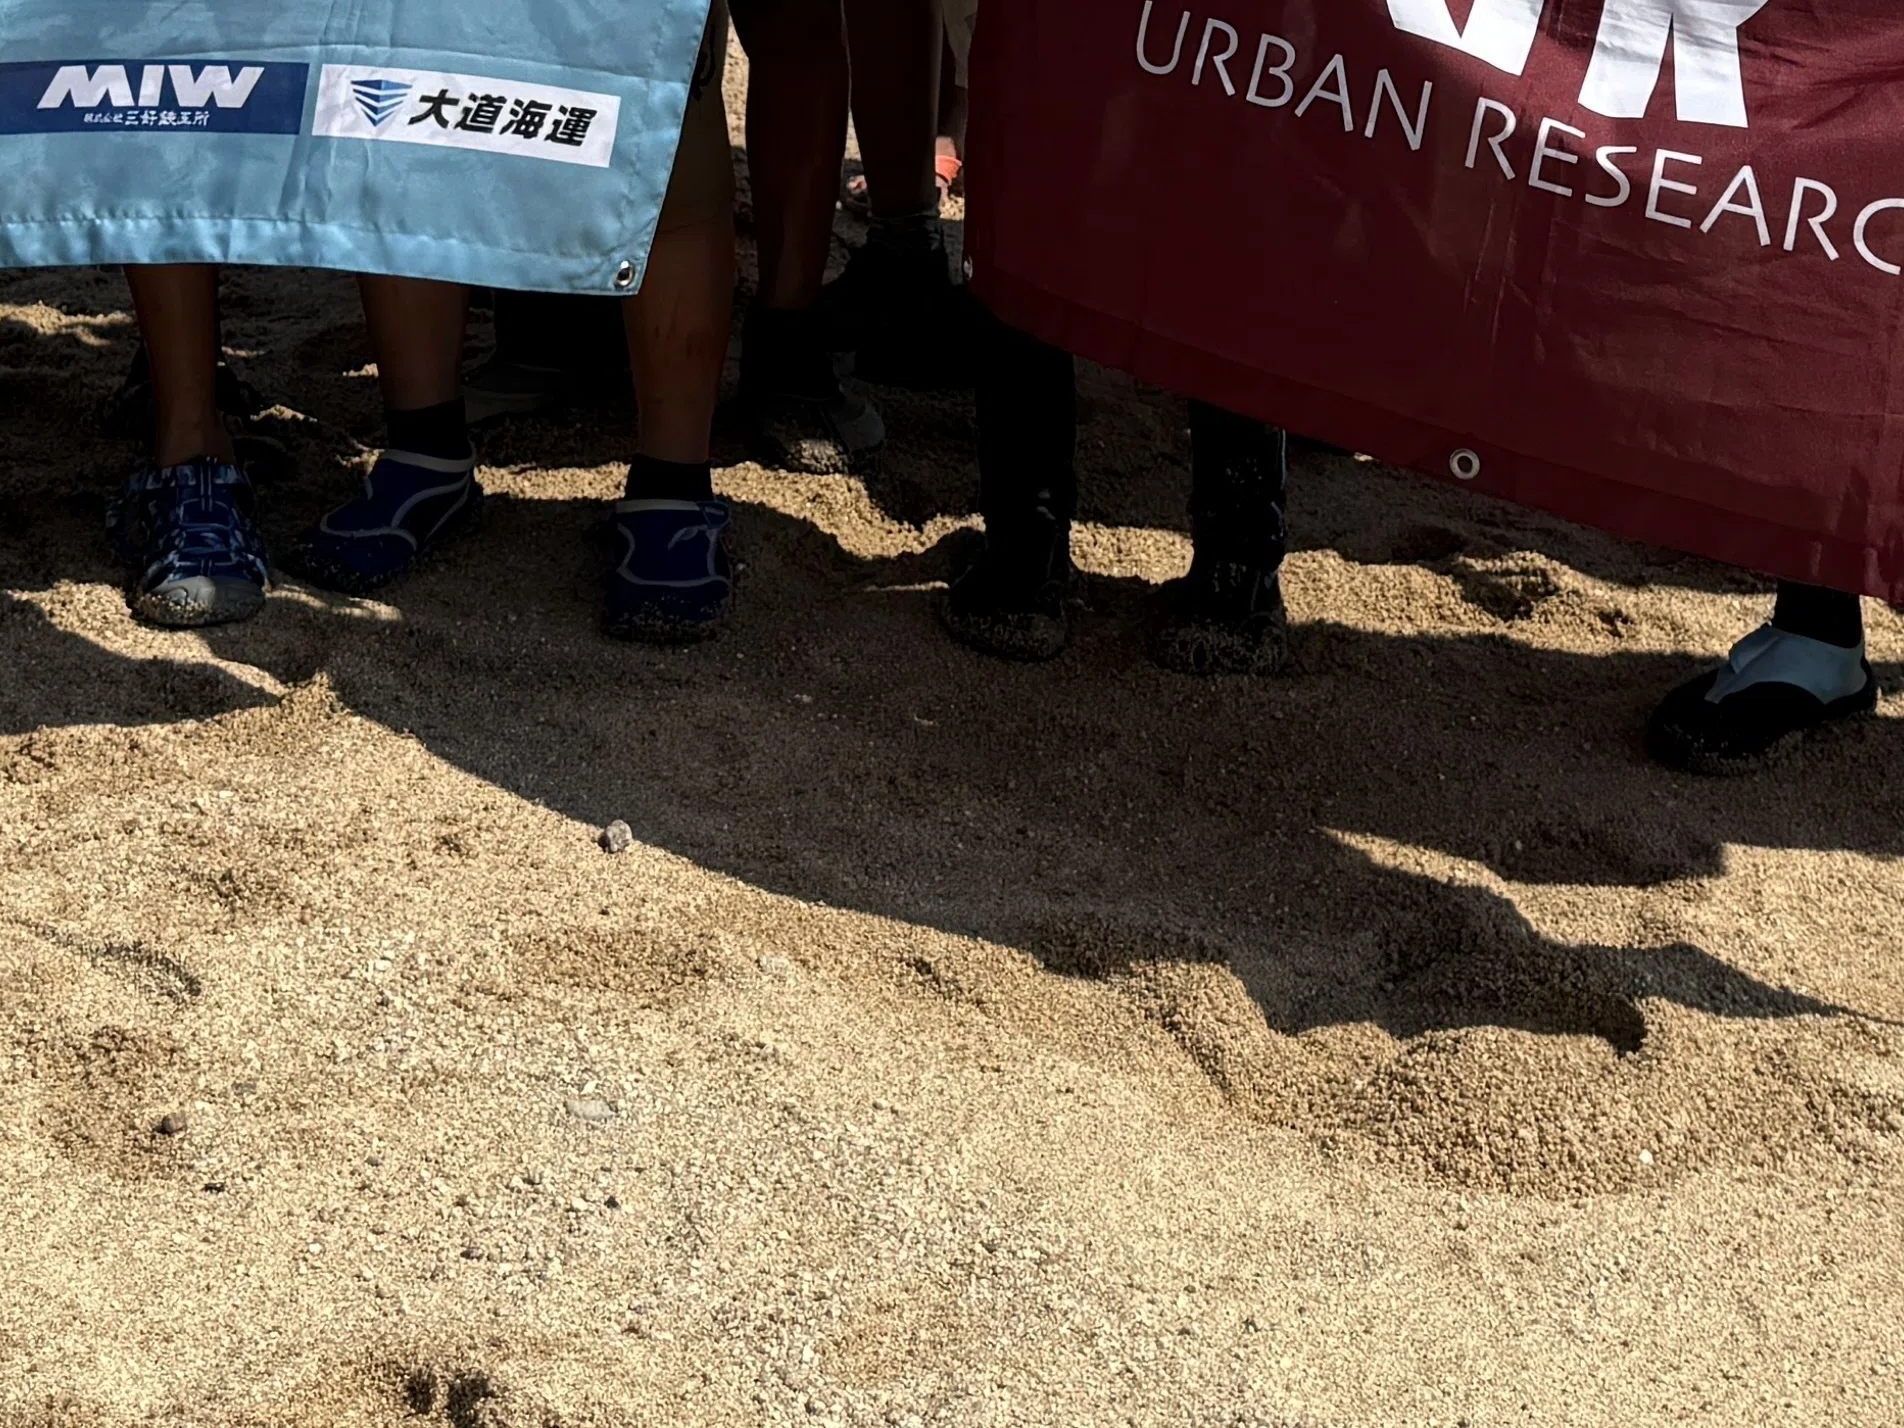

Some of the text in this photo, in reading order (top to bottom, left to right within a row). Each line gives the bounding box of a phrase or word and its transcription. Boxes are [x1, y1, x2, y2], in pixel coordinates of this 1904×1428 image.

[36, 65, 265, 109] MIW
[1135, 0, 1433, 151] URBAN
[407, 88, 598, 148] 大道海運
